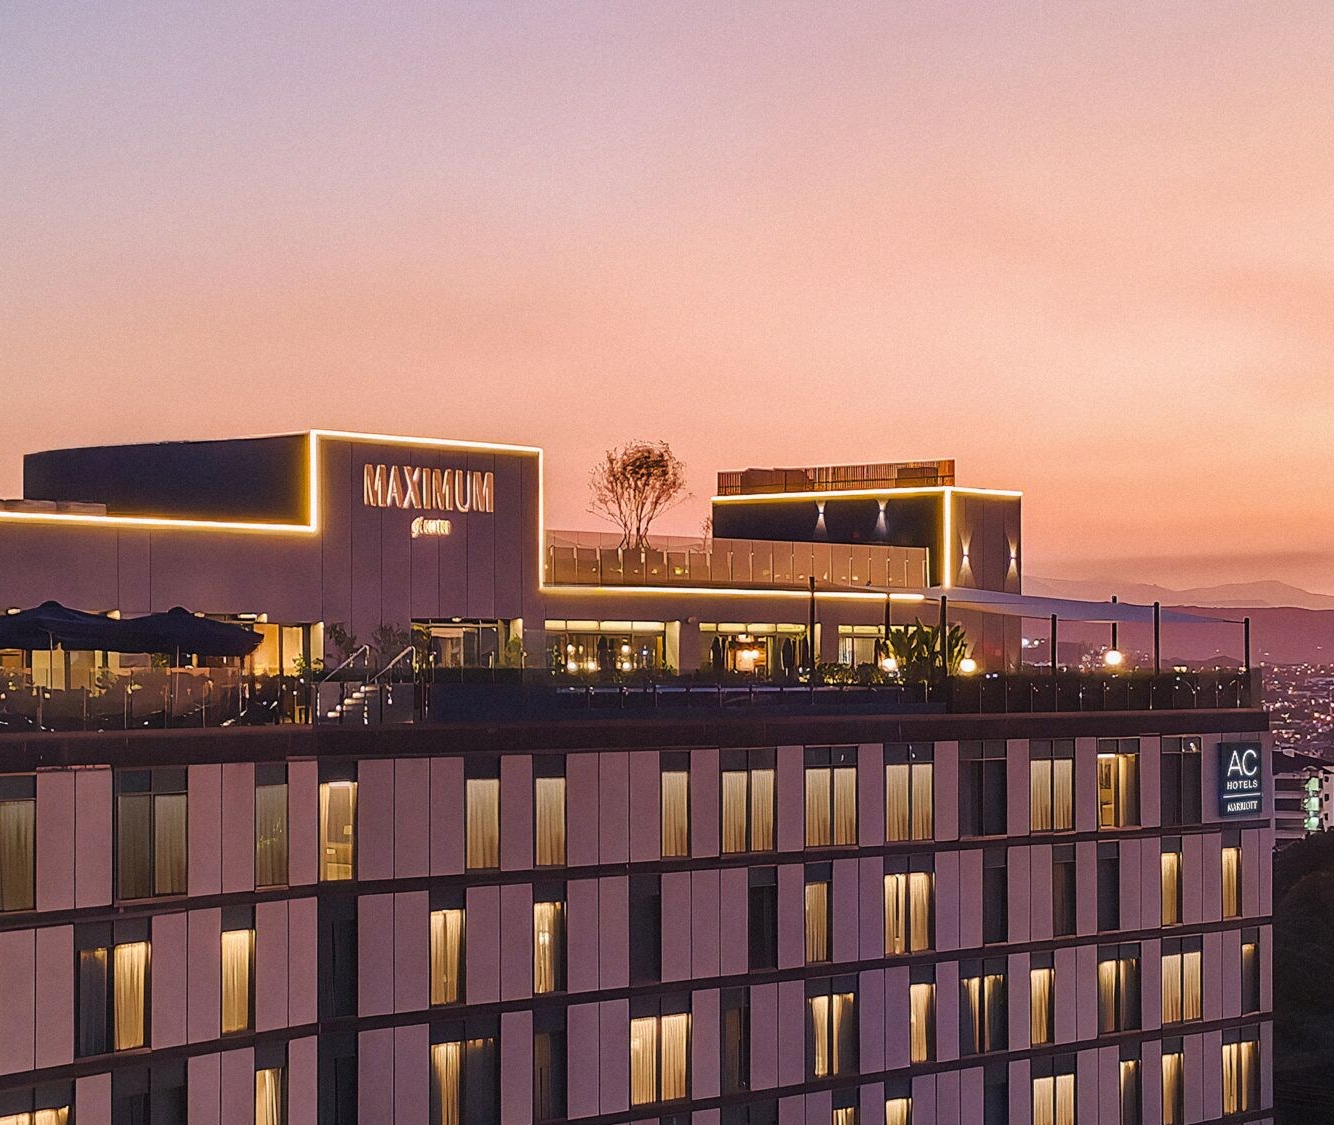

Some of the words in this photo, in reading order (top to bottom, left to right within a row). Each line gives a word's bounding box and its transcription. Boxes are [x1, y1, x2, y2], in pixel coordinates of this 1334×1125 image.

[363, 463, 495, 513] MAXIMUM
[1227, 749, 1258, 777] AC
[1226, 779, 1258, 790] HOTELS
